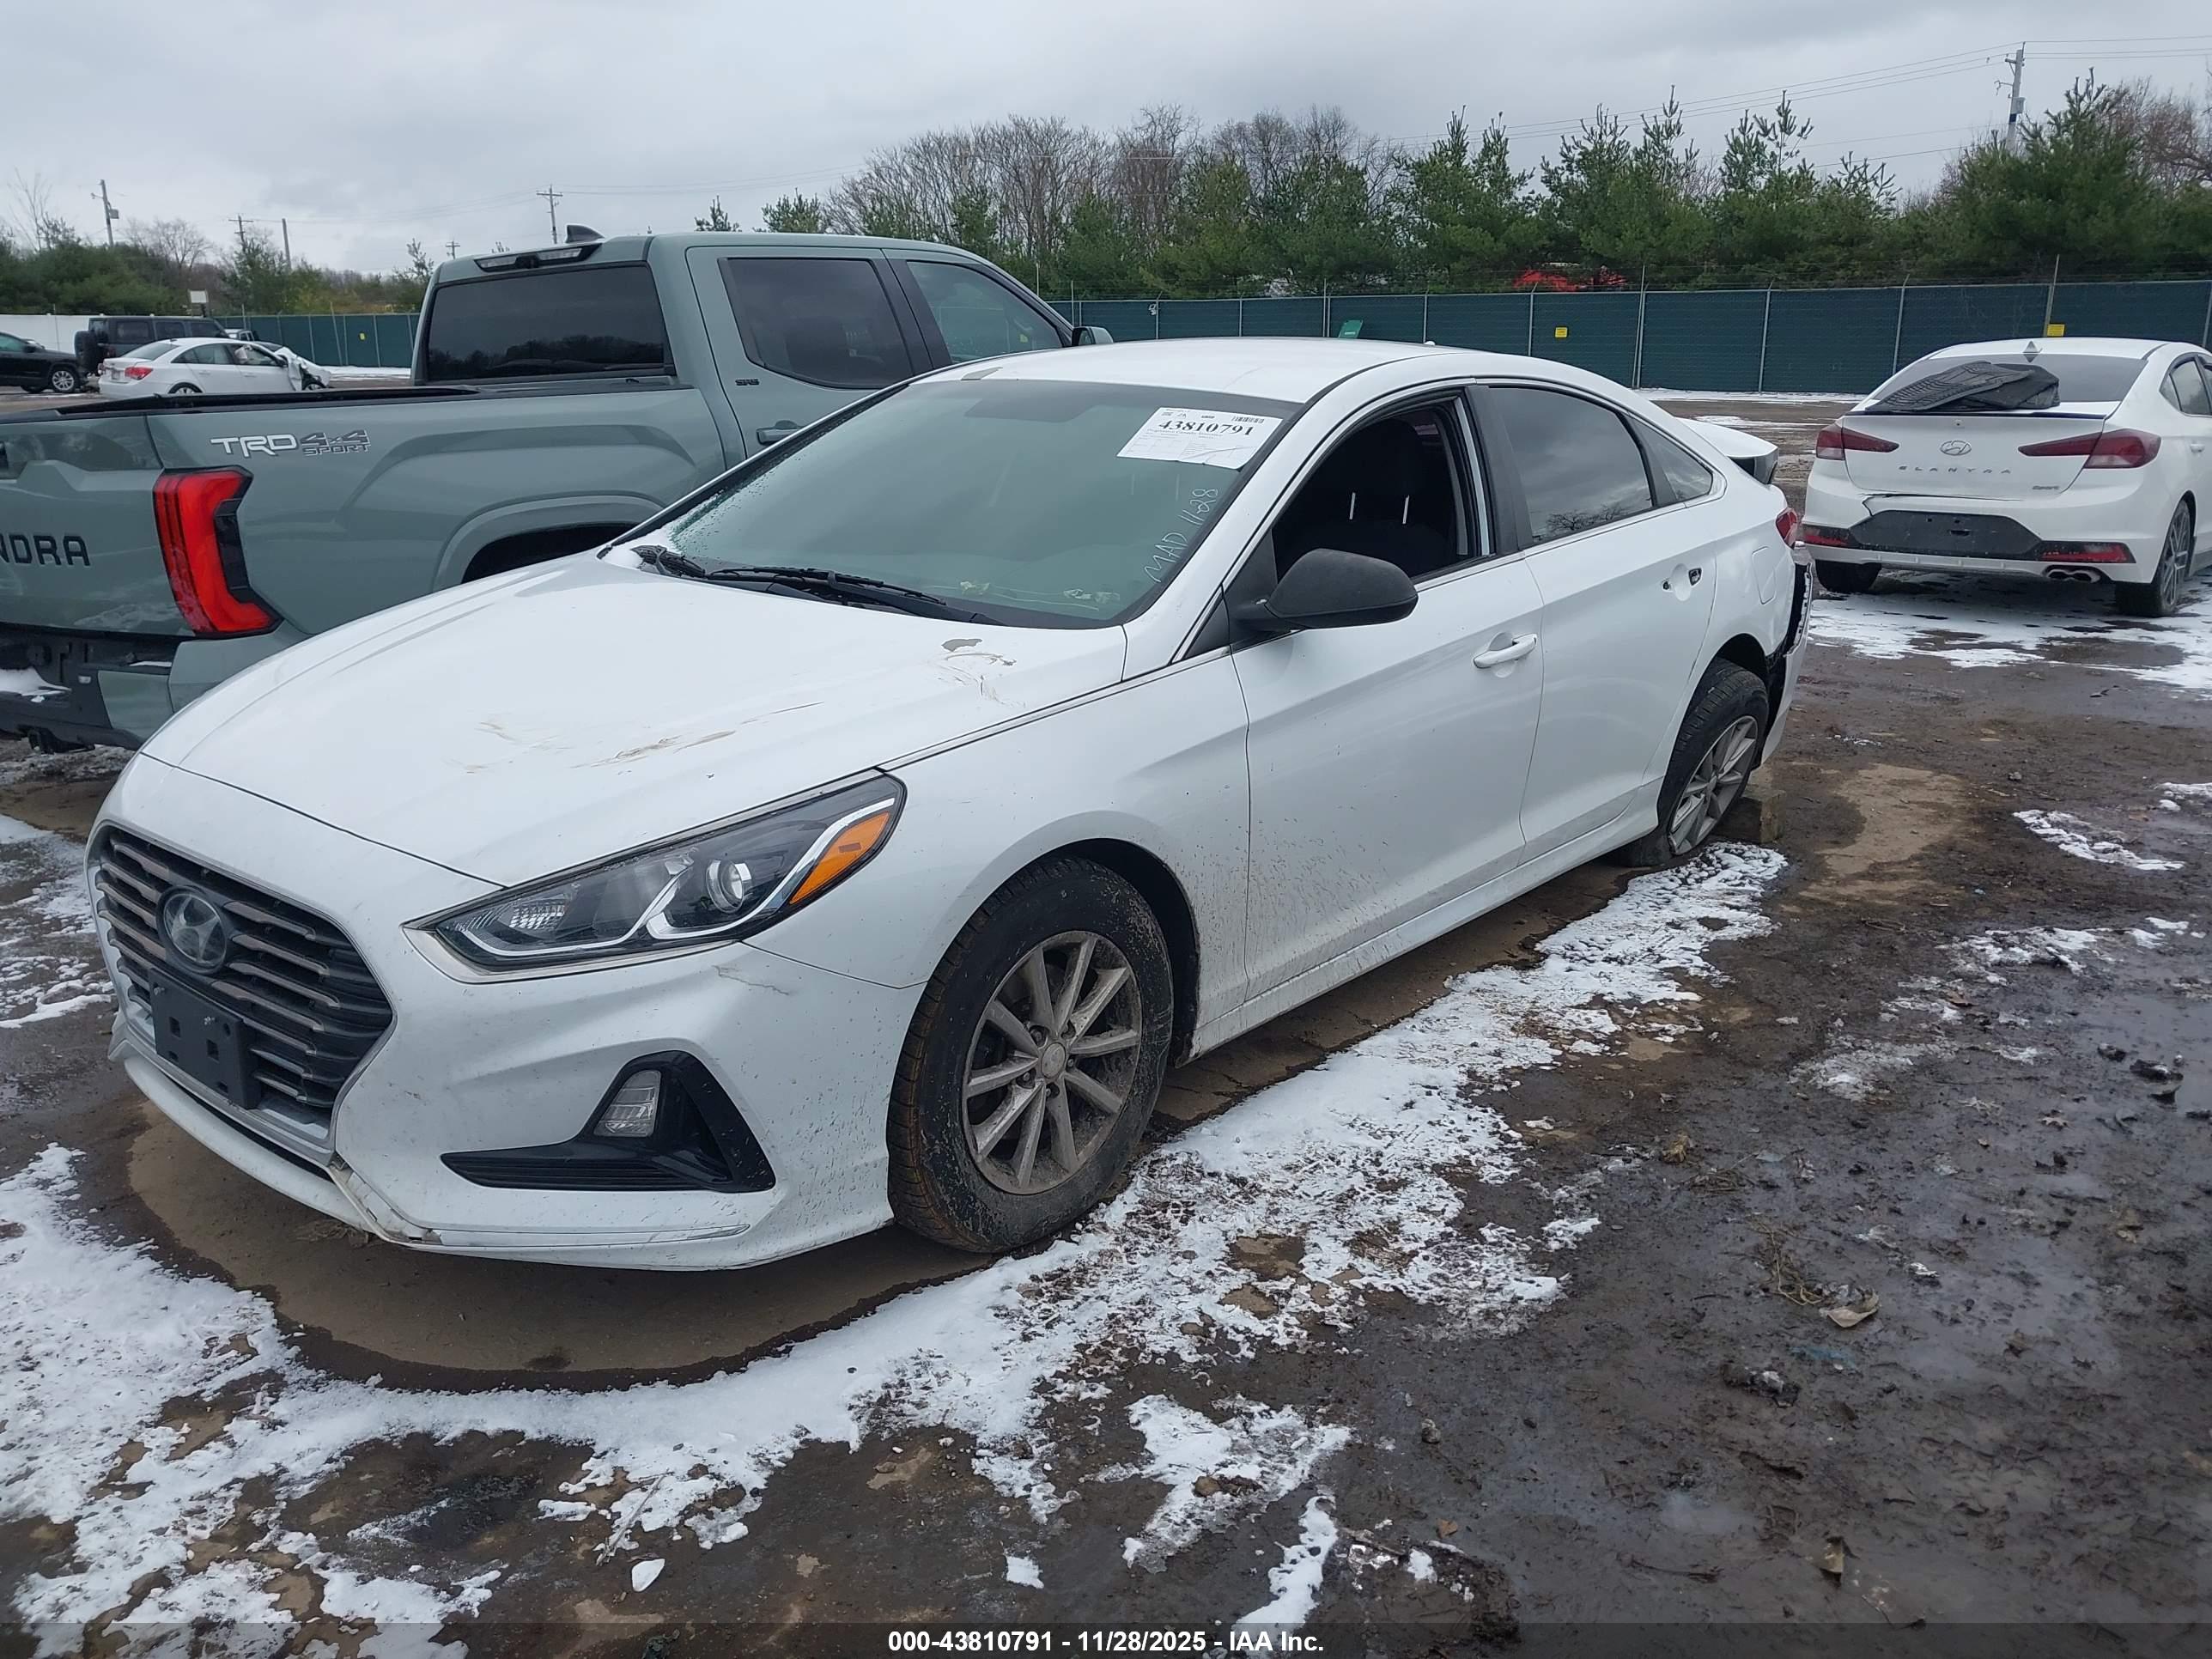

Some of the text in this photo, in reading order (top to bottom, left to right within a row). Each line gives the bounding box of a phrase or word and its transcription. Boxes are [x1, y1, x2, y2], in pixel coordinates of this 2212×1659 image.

[1158, 420, 1254, 435] 43810791
[210, 434, 300, 458] TRD
[301, 444, 372, 456] SPORT
[1899, 465, 2011, 474] ELANTRA
[1145, 532, 1188, 583] MAD
